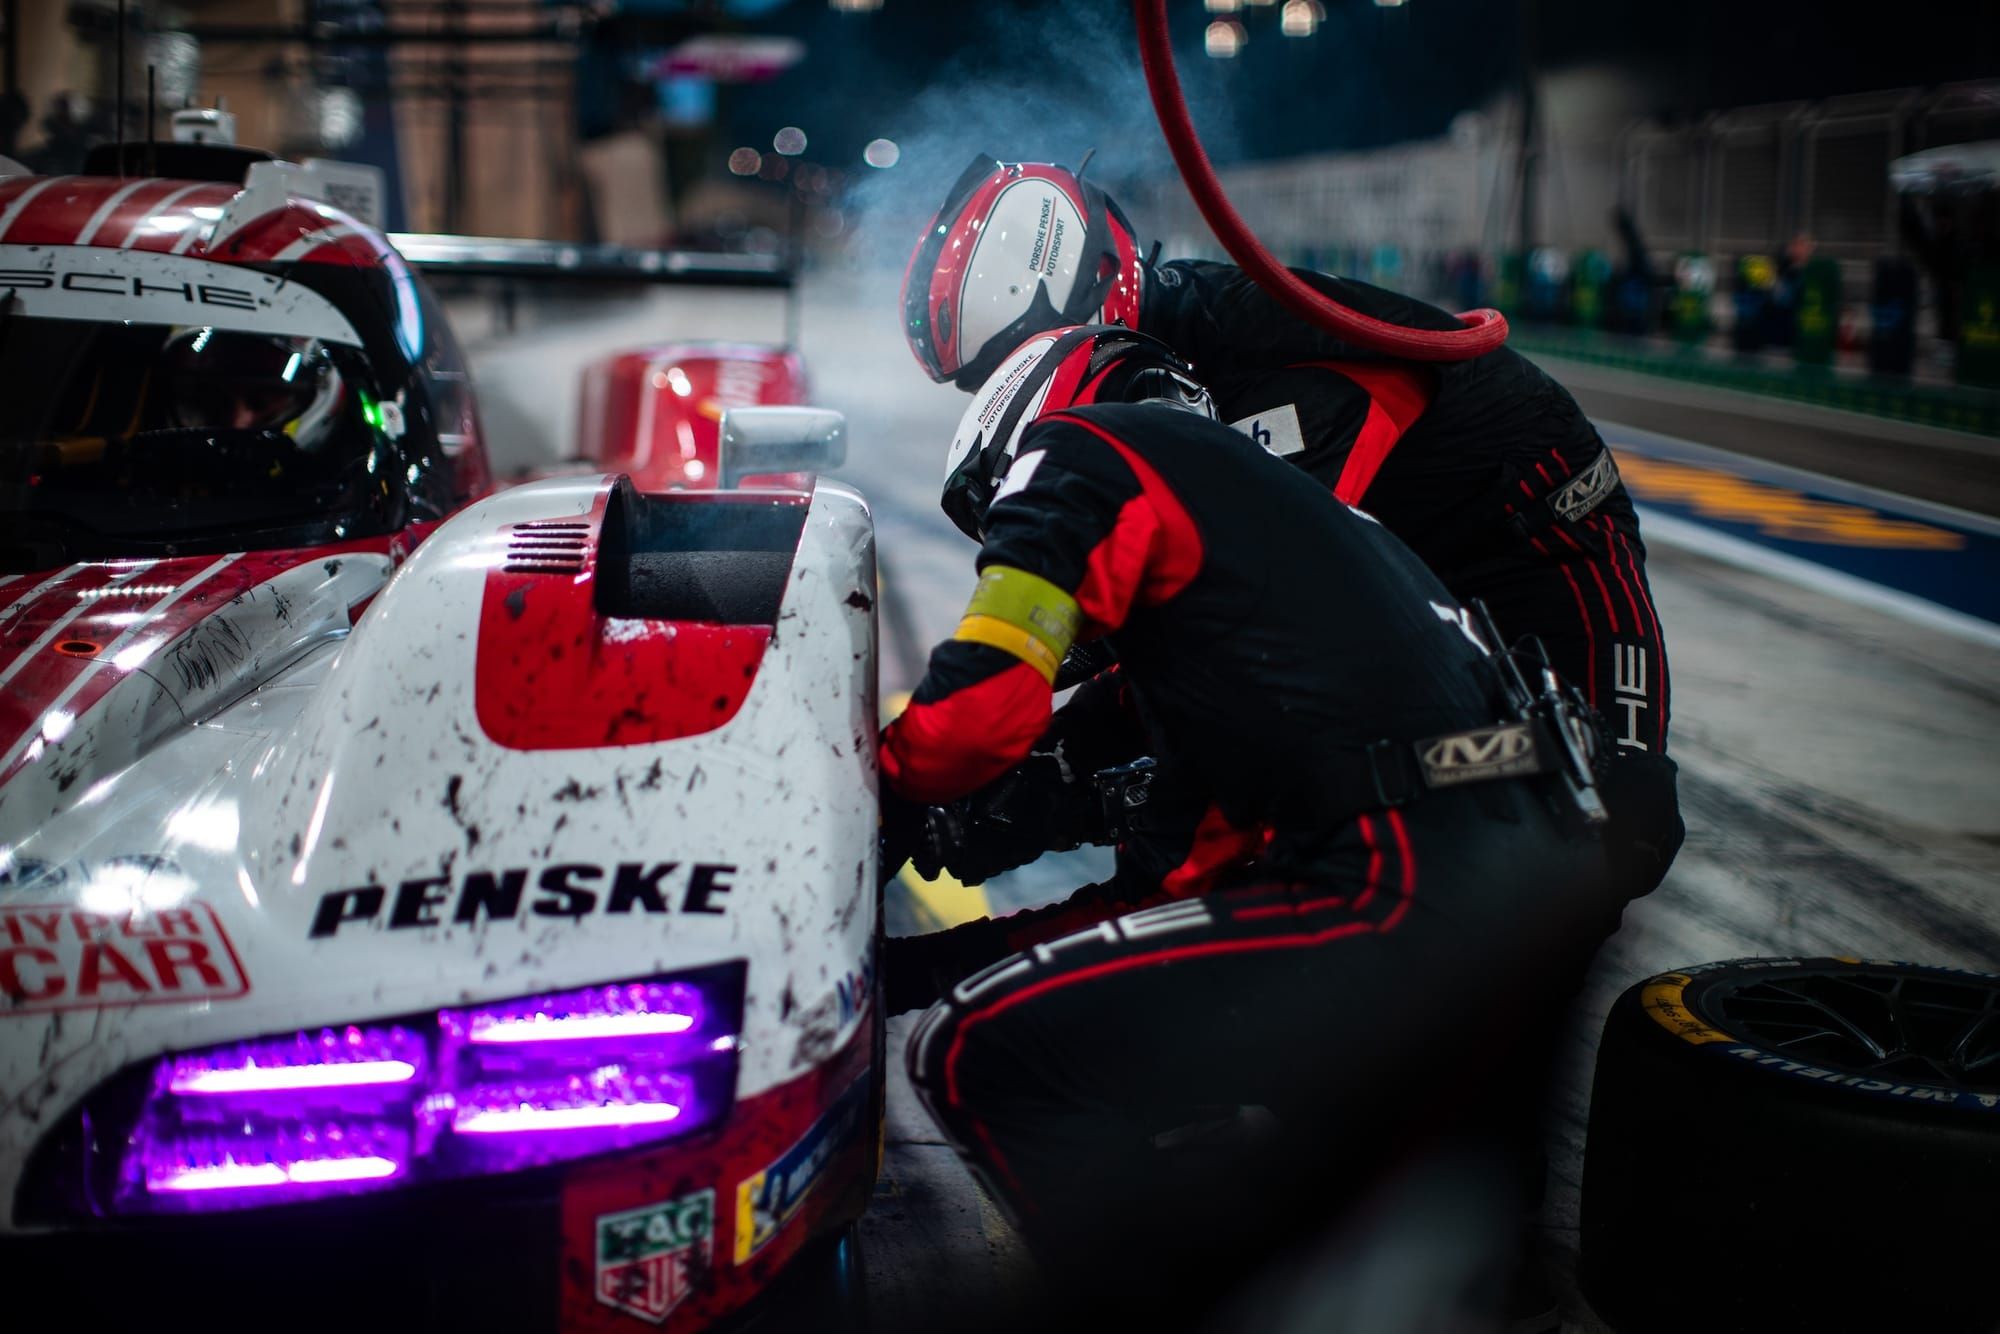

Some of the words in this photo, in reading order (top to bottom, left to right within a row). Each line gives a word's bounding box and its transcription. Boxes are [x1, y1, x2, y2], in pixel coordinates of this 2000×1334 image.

[1029, 229, 1046, 271] PORSCHE
[1039, 197, 1051, 230] PENSKE
[1045, 218, 1065, 277] MOTORSPORT
[1005, 353, 1033, 384] PENSKE
[308, 863, 739, 940] PENSKE
[0, 938, 227, 1002] CAR
[1728, 1049, 1960, 1103] MICHELIN
